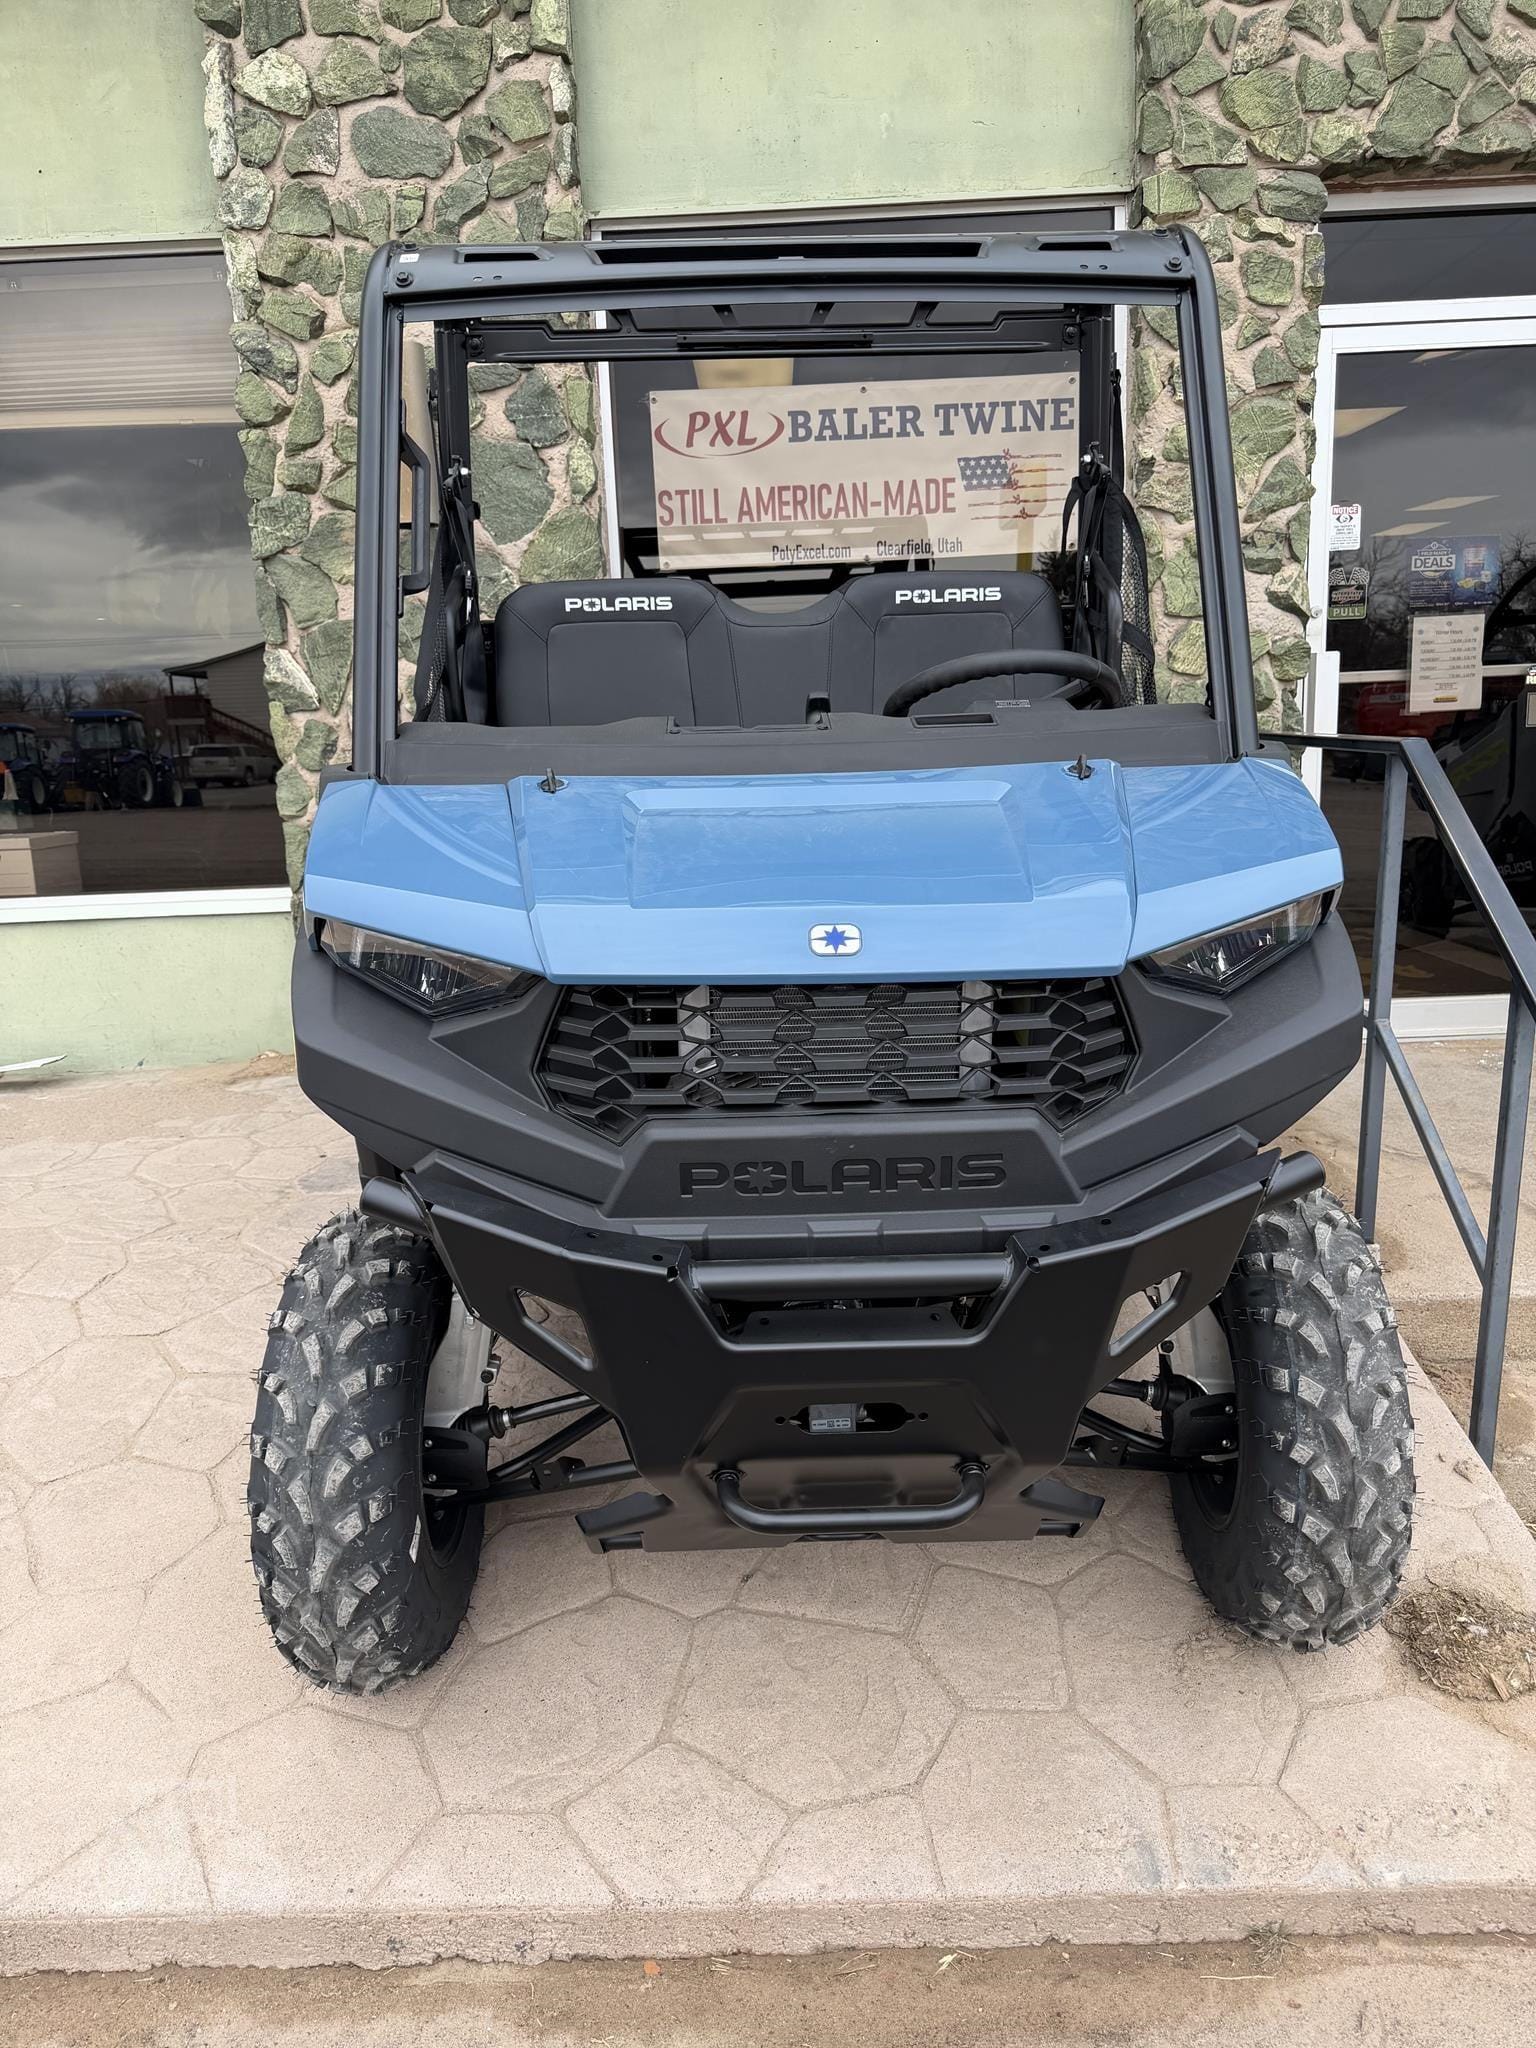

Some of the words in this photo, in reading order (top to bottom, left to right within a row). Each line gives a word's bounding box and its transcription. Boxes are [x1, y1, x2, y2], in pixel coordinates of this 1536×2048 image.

[686, 410, 758, 448] PXL
[788, 405, 924, 443] BALER
[934, 397, 1075, 436] TWINE
[657, 488, 728, 526] STILL
[737, 477, 956, 523] AMERICAN-MADE
[1333, 506, 1359, 515] NOTICE
[772, 543, 851, 565] PolyExcel.com
[876, 539, 935, 557] Clearfield,
[938, 537, 962, 554] Utah
[1413, 557, 1453, 569] DEALS
[565, 596, 673, 612] POLARIS
[895, 587, 1002, 604] POLARIS
[1333, 607, 1360, 617] PULL
[679, 1153, 1007, 1198] POLARIS
